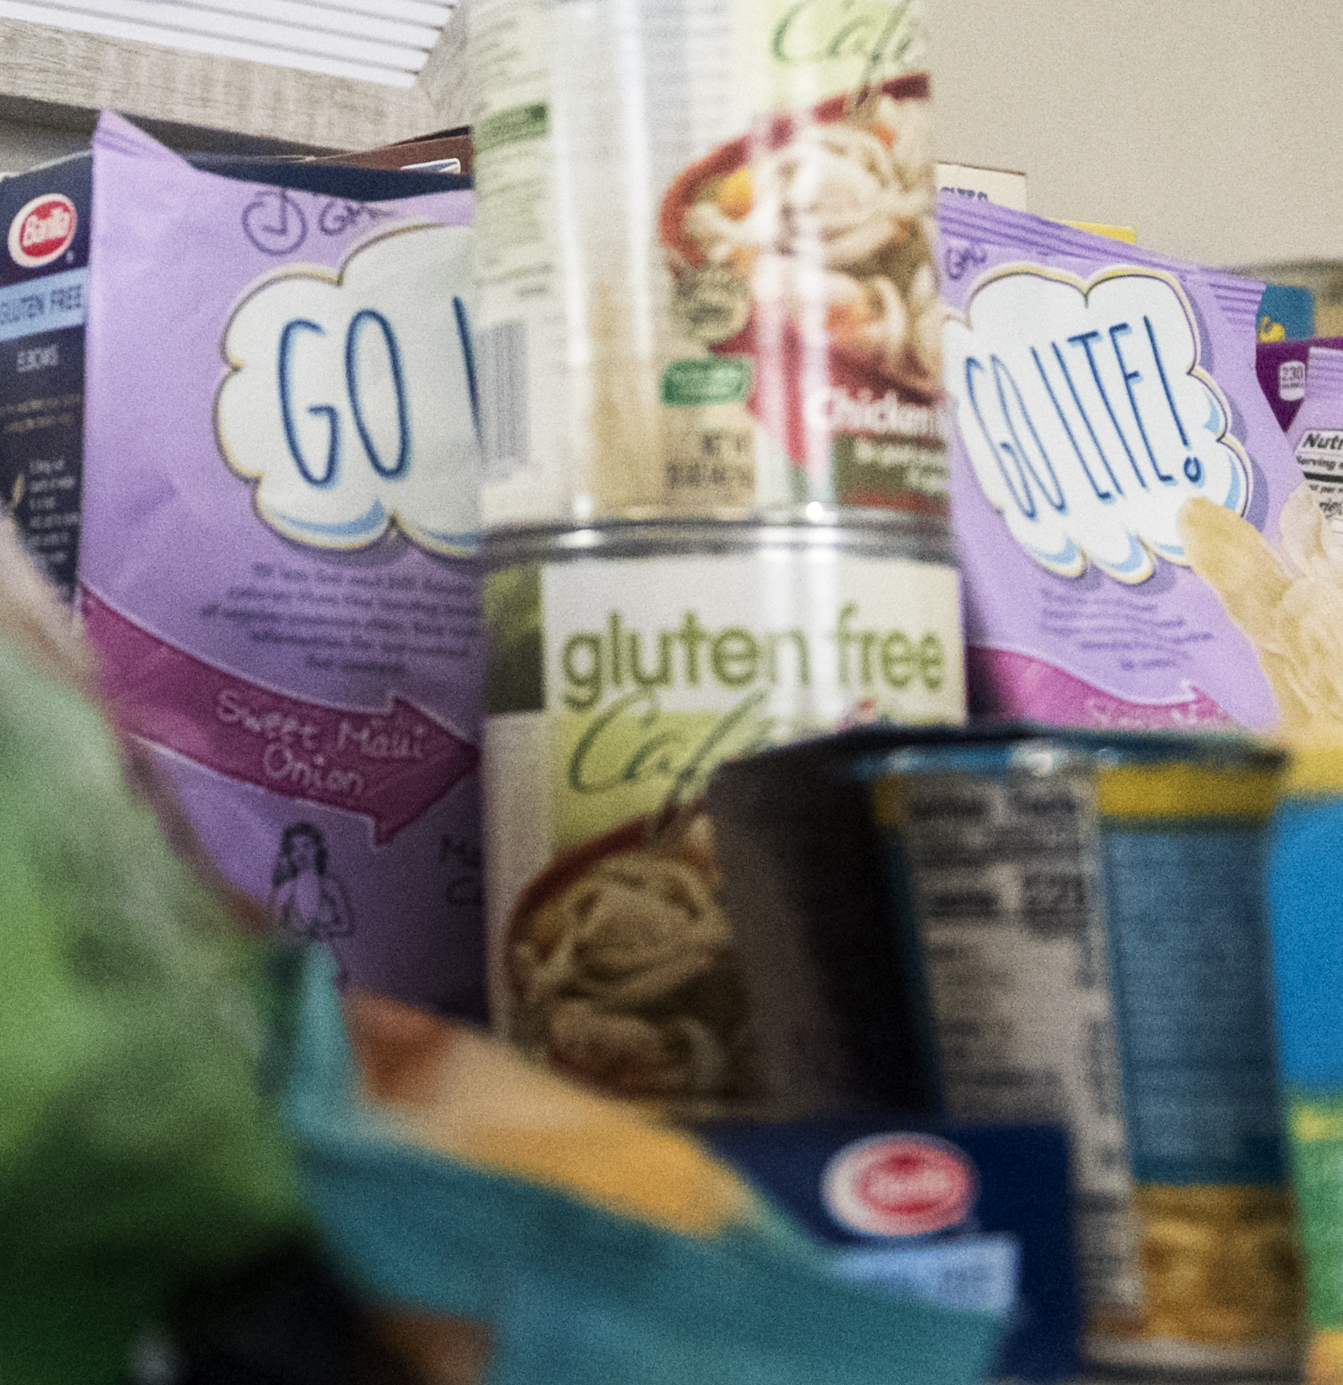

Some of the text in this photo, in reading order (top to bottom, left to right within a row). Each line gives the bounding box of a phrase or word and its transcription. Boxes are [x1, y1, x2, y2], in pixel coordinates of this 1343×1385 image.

[277, 308, 412, 488] GO
[1296, 455, 1336, 471] Serving
[561, 609, 811, 709] gluten
[835, 602, 945, 693] free
[568, 682, 773, 831] Caf
